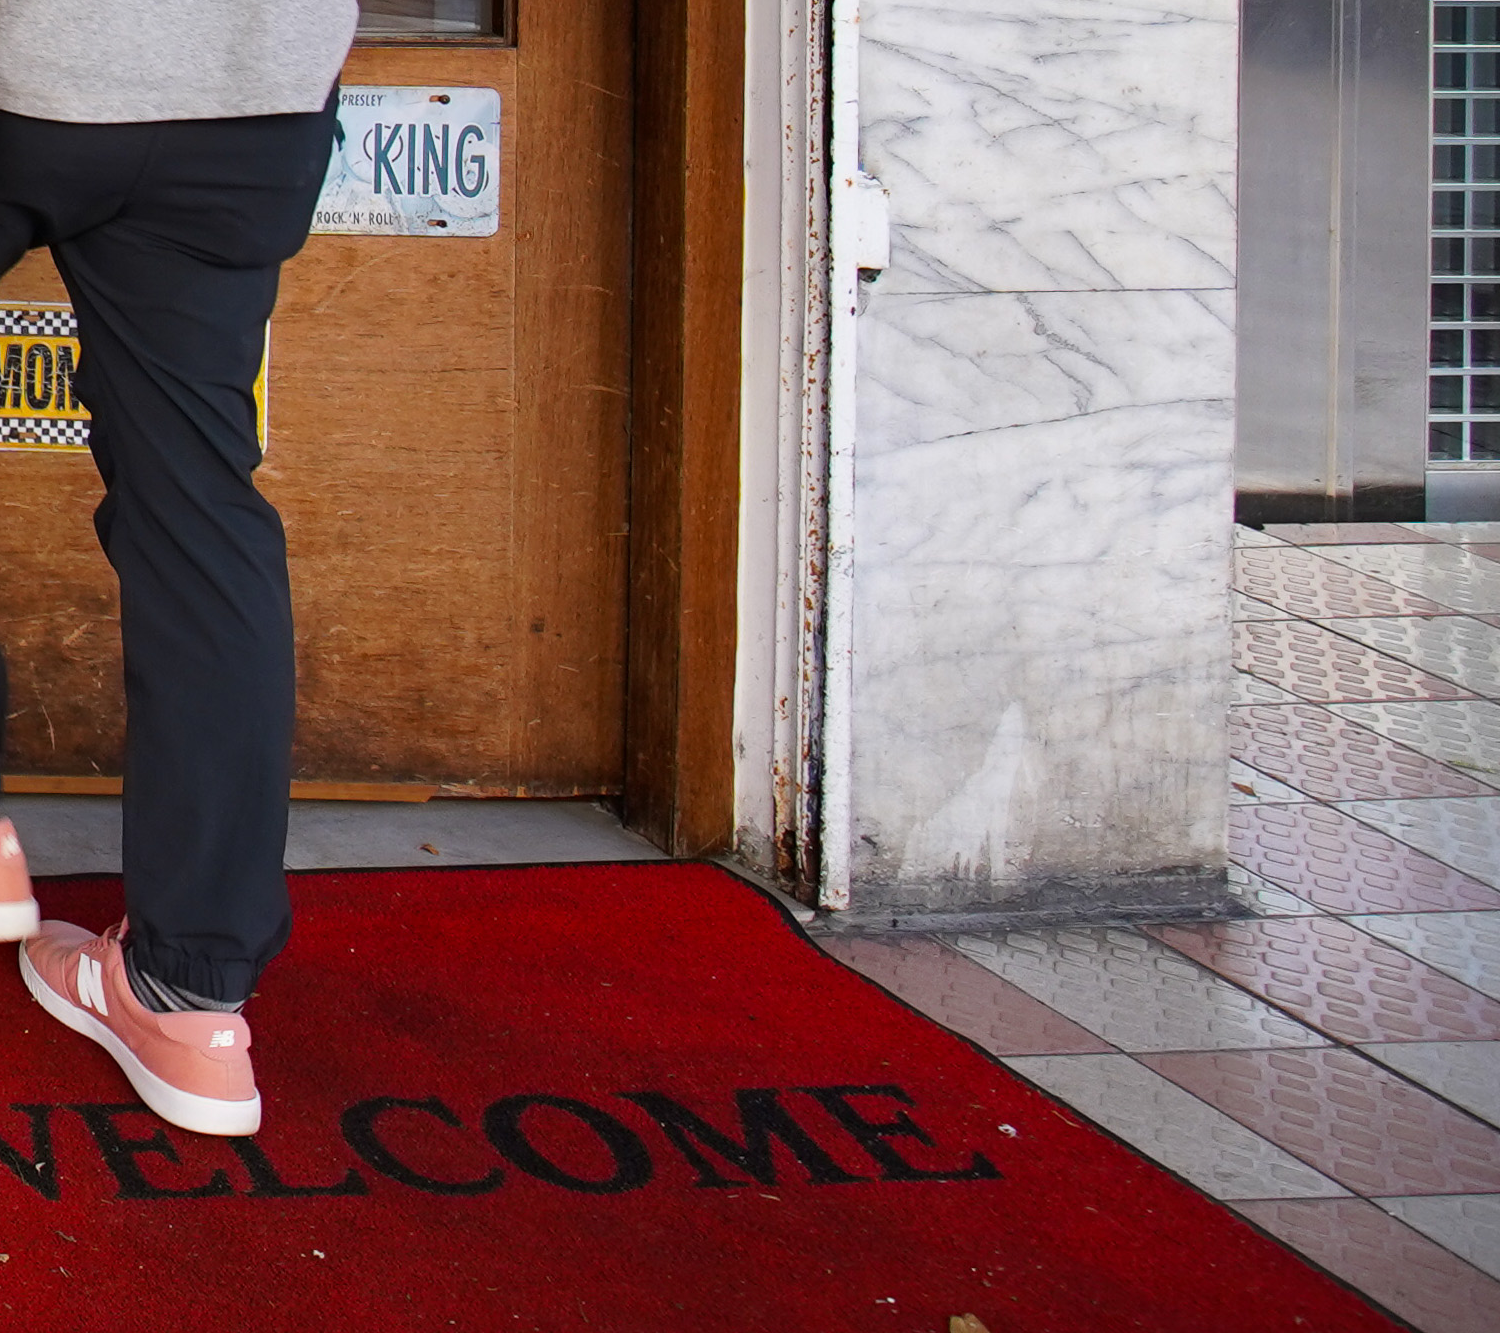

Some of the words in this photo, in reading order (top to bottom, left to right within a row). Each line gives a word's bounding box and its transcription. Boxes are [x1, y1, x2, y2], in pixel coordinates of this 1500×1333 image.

[372, 121, 488, 200] KING
[315, 211, 347, 226] ROCK
[369, 210, 395, 225] ROLL
